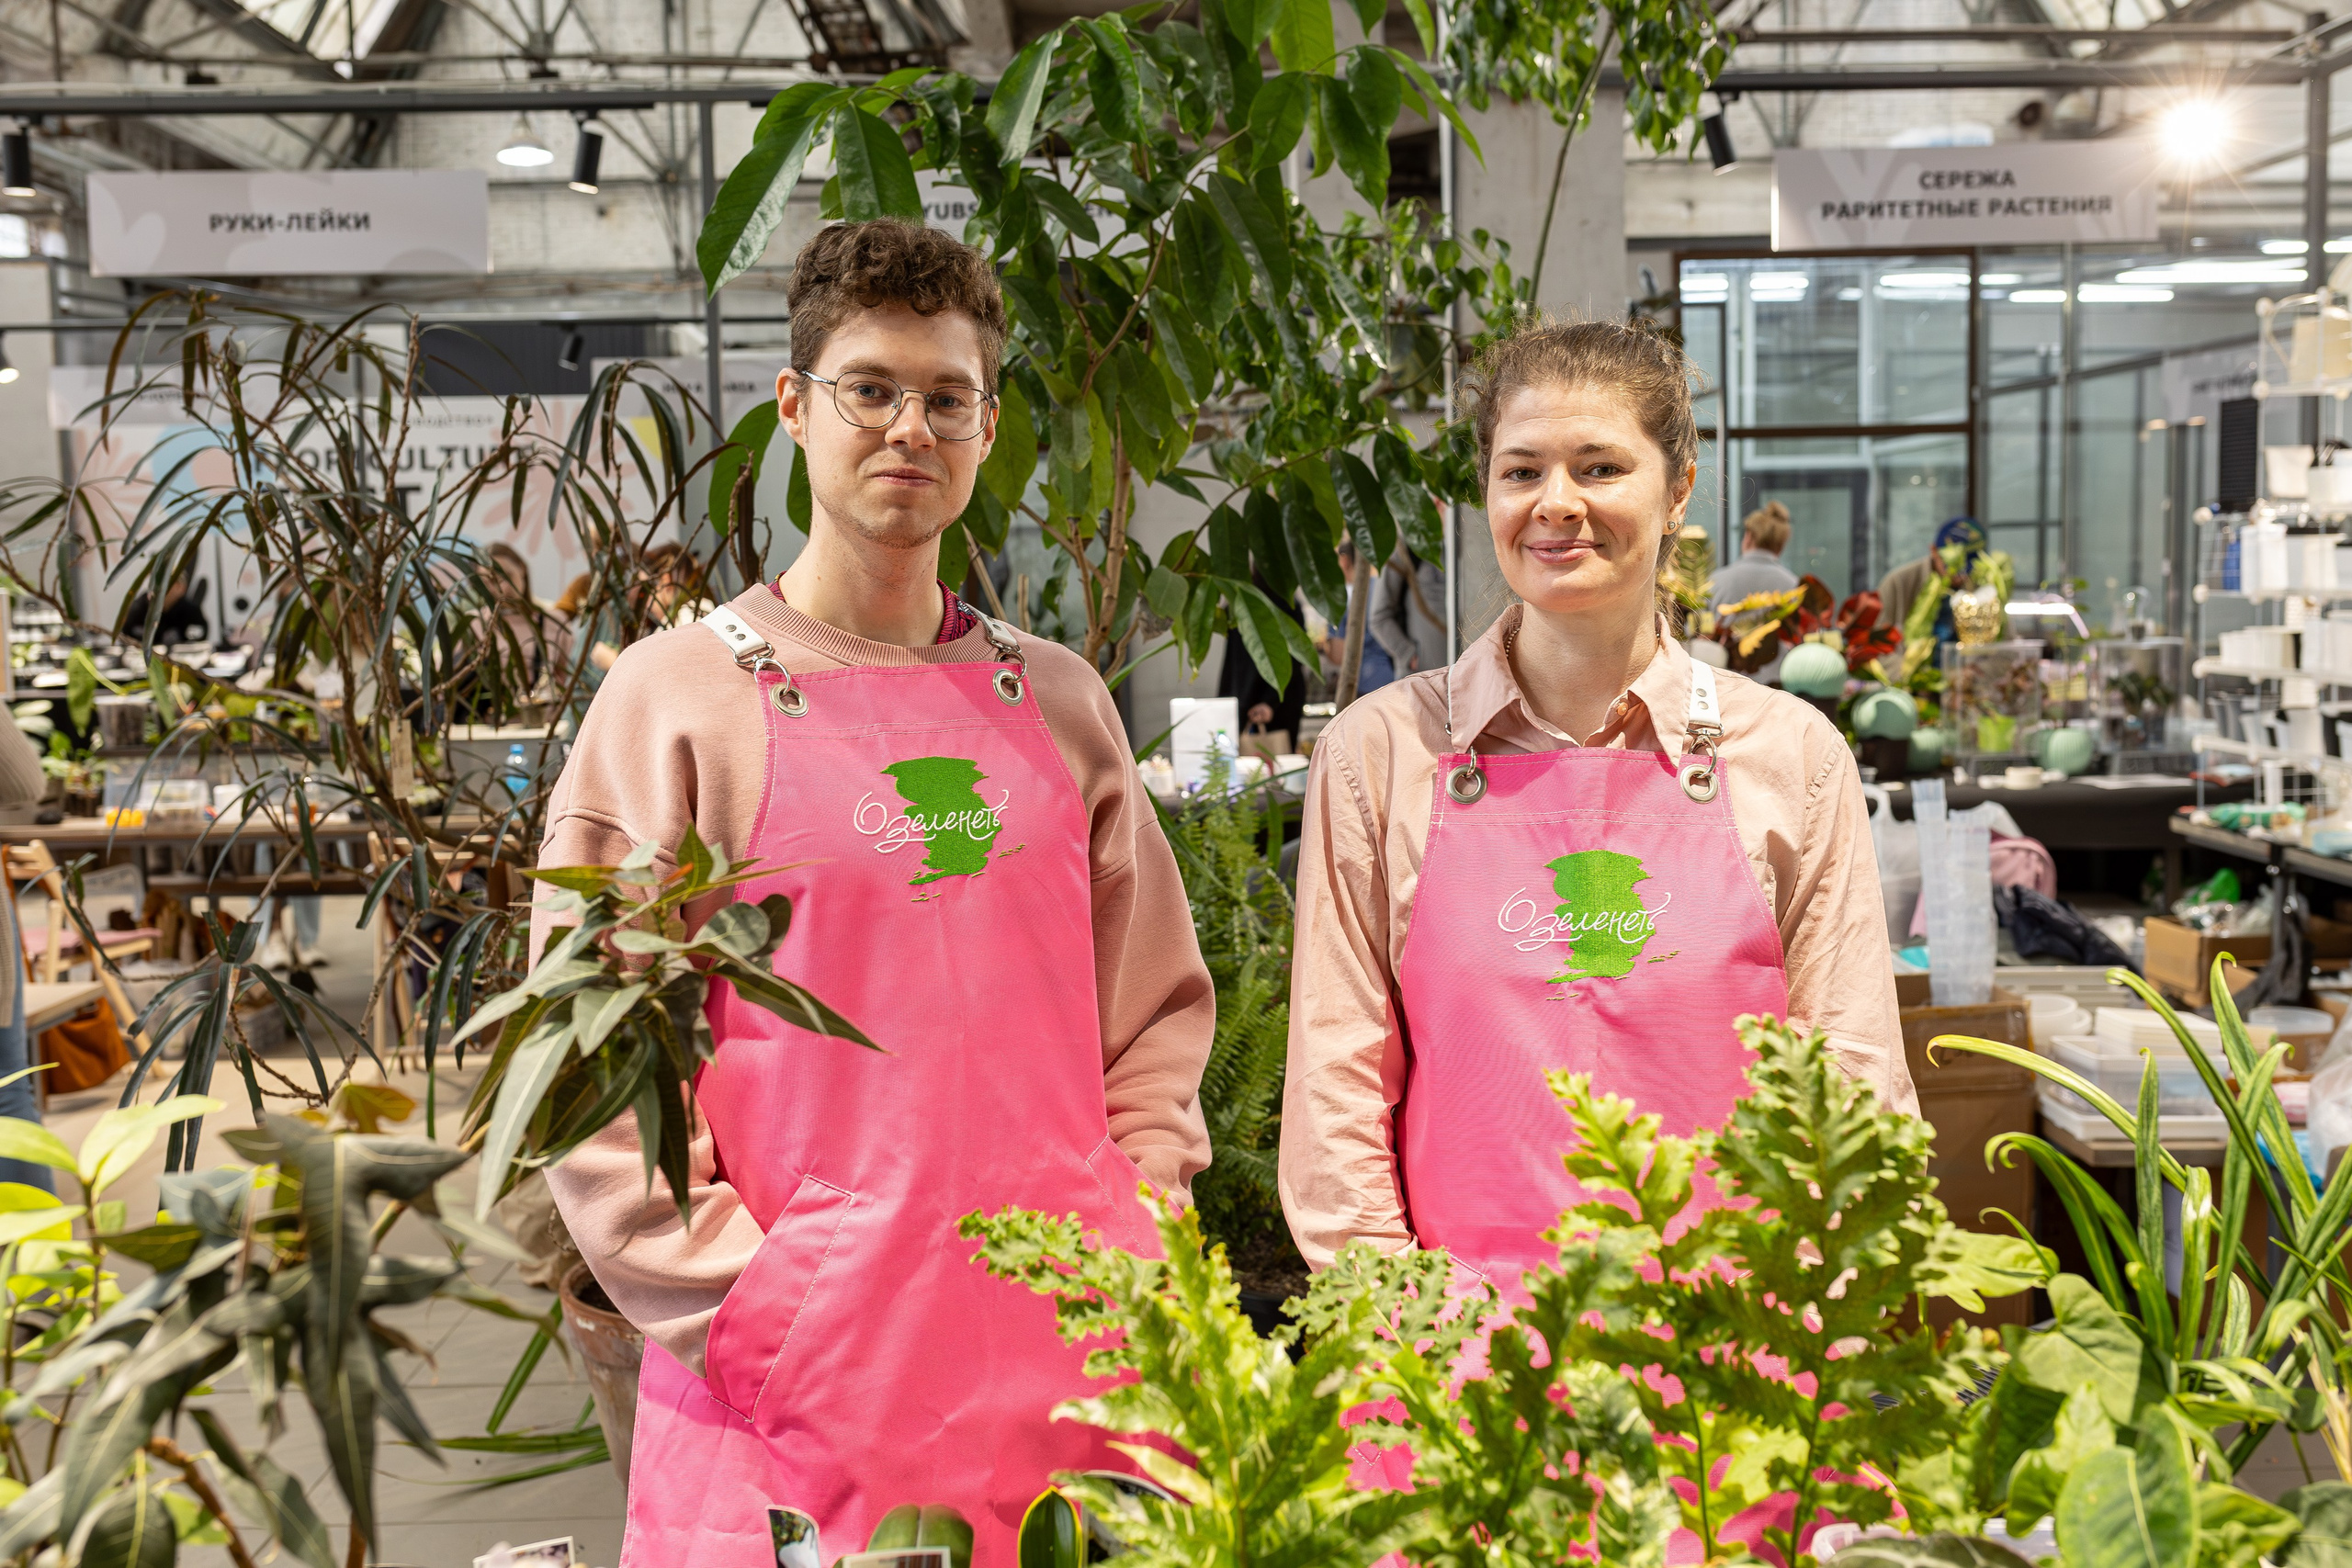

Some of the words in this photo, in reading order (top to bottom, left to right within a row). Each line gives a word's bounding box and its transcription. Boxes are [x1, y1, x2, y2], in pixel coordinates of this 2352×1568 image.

[1918, 169, 2017, 190] СЕРЕЖА
[209, 207, 371, 231] РУКИ-ЛЕЙКИ
[1821, 197, 1981, 220] РАРИТЕТНЫЕ
[1987, 195, 2112, 218] РАСТЕНИЯ
[854, 789, 1010, 854] Озеленеть
[1498, 886, 1672, 953] Озеленеть
